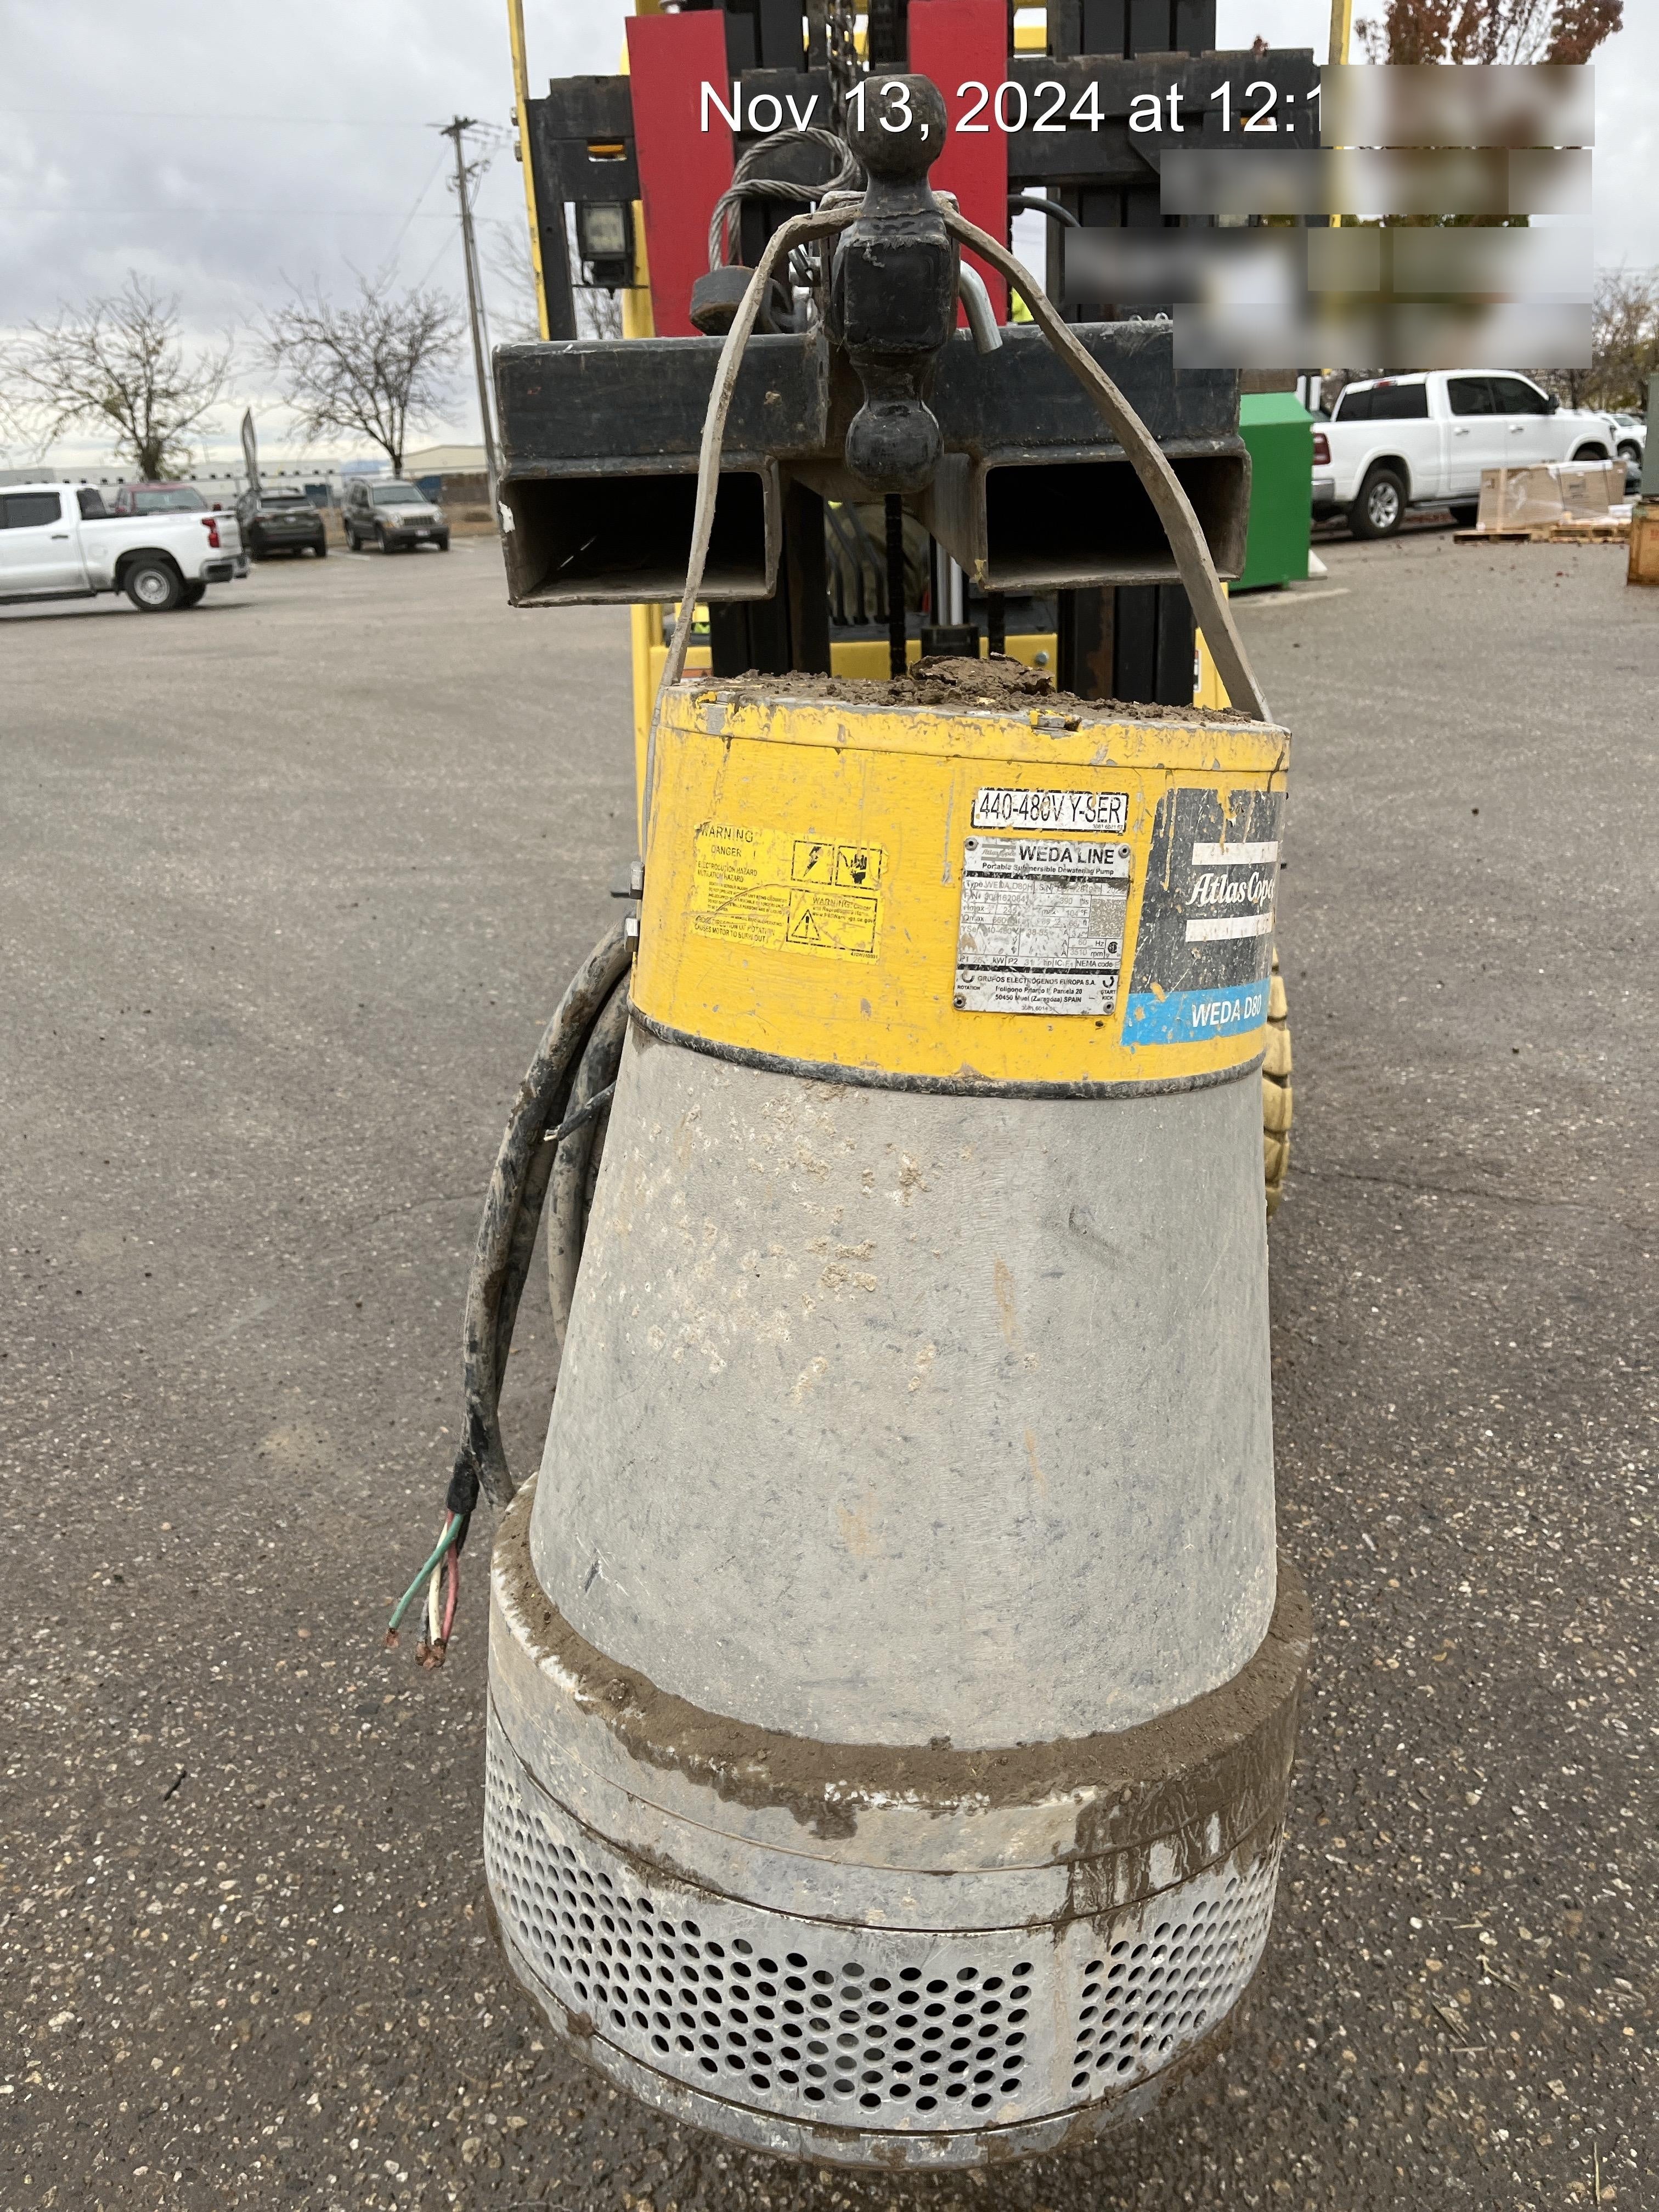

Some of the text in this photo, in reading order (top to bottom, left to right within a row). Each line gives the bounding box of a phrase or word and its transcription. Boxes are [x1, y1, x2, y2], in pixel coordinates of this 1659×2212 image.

[980, 793, 1121, 823] 440-480V Y-SER
[1019, 846, 1114, 865] WEDA LINE
[1185, 873, 1247, 907] Atlas
[1192, 994, 1262, 1028] WEDA D80
